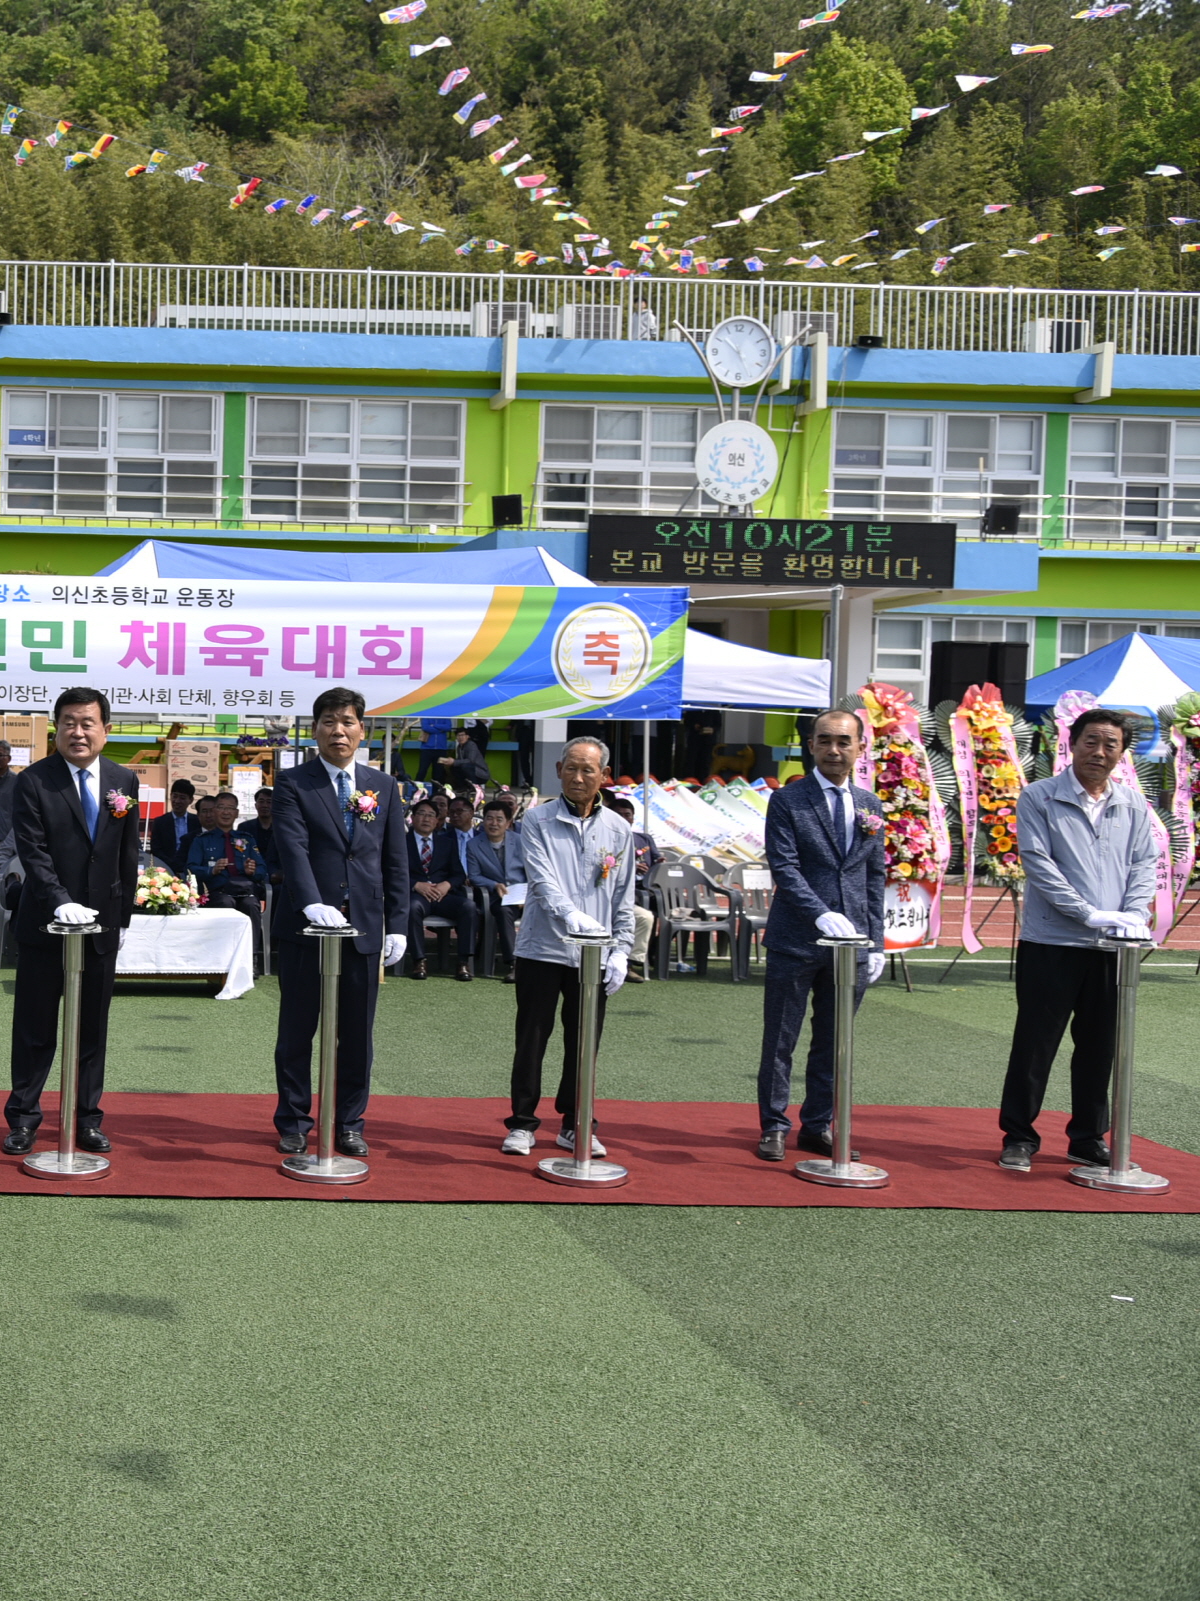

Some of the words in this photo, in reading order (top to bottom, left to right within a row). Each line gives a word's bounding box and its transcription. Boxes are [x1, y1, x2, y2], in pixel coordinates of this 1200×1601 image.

[734, 324, 745, 333] 12
[711, 348, 718, 356] 9
[760, 349, 766, 357] 3
[735, 372, 741, 381] 6
[727, 452, 746, 467] 의신
[610, 549, 664, 575] 본교
[682, 550, 764, 577] 방문을
[781, 553, 933, 580] 환영합니다.
[51, 585, 169, 606] 의신초등학교
[176, 587, 235, 607] 운동장
[117, 619, 424, 682] 체육대회
[580, 630, 621, 677] 축
[178, 688, 216, 707] 단체,
[222, 689, 274, 708] 향우회
[278, 690, 296, 708] 등
[895, 882, 911, 902] 祝
